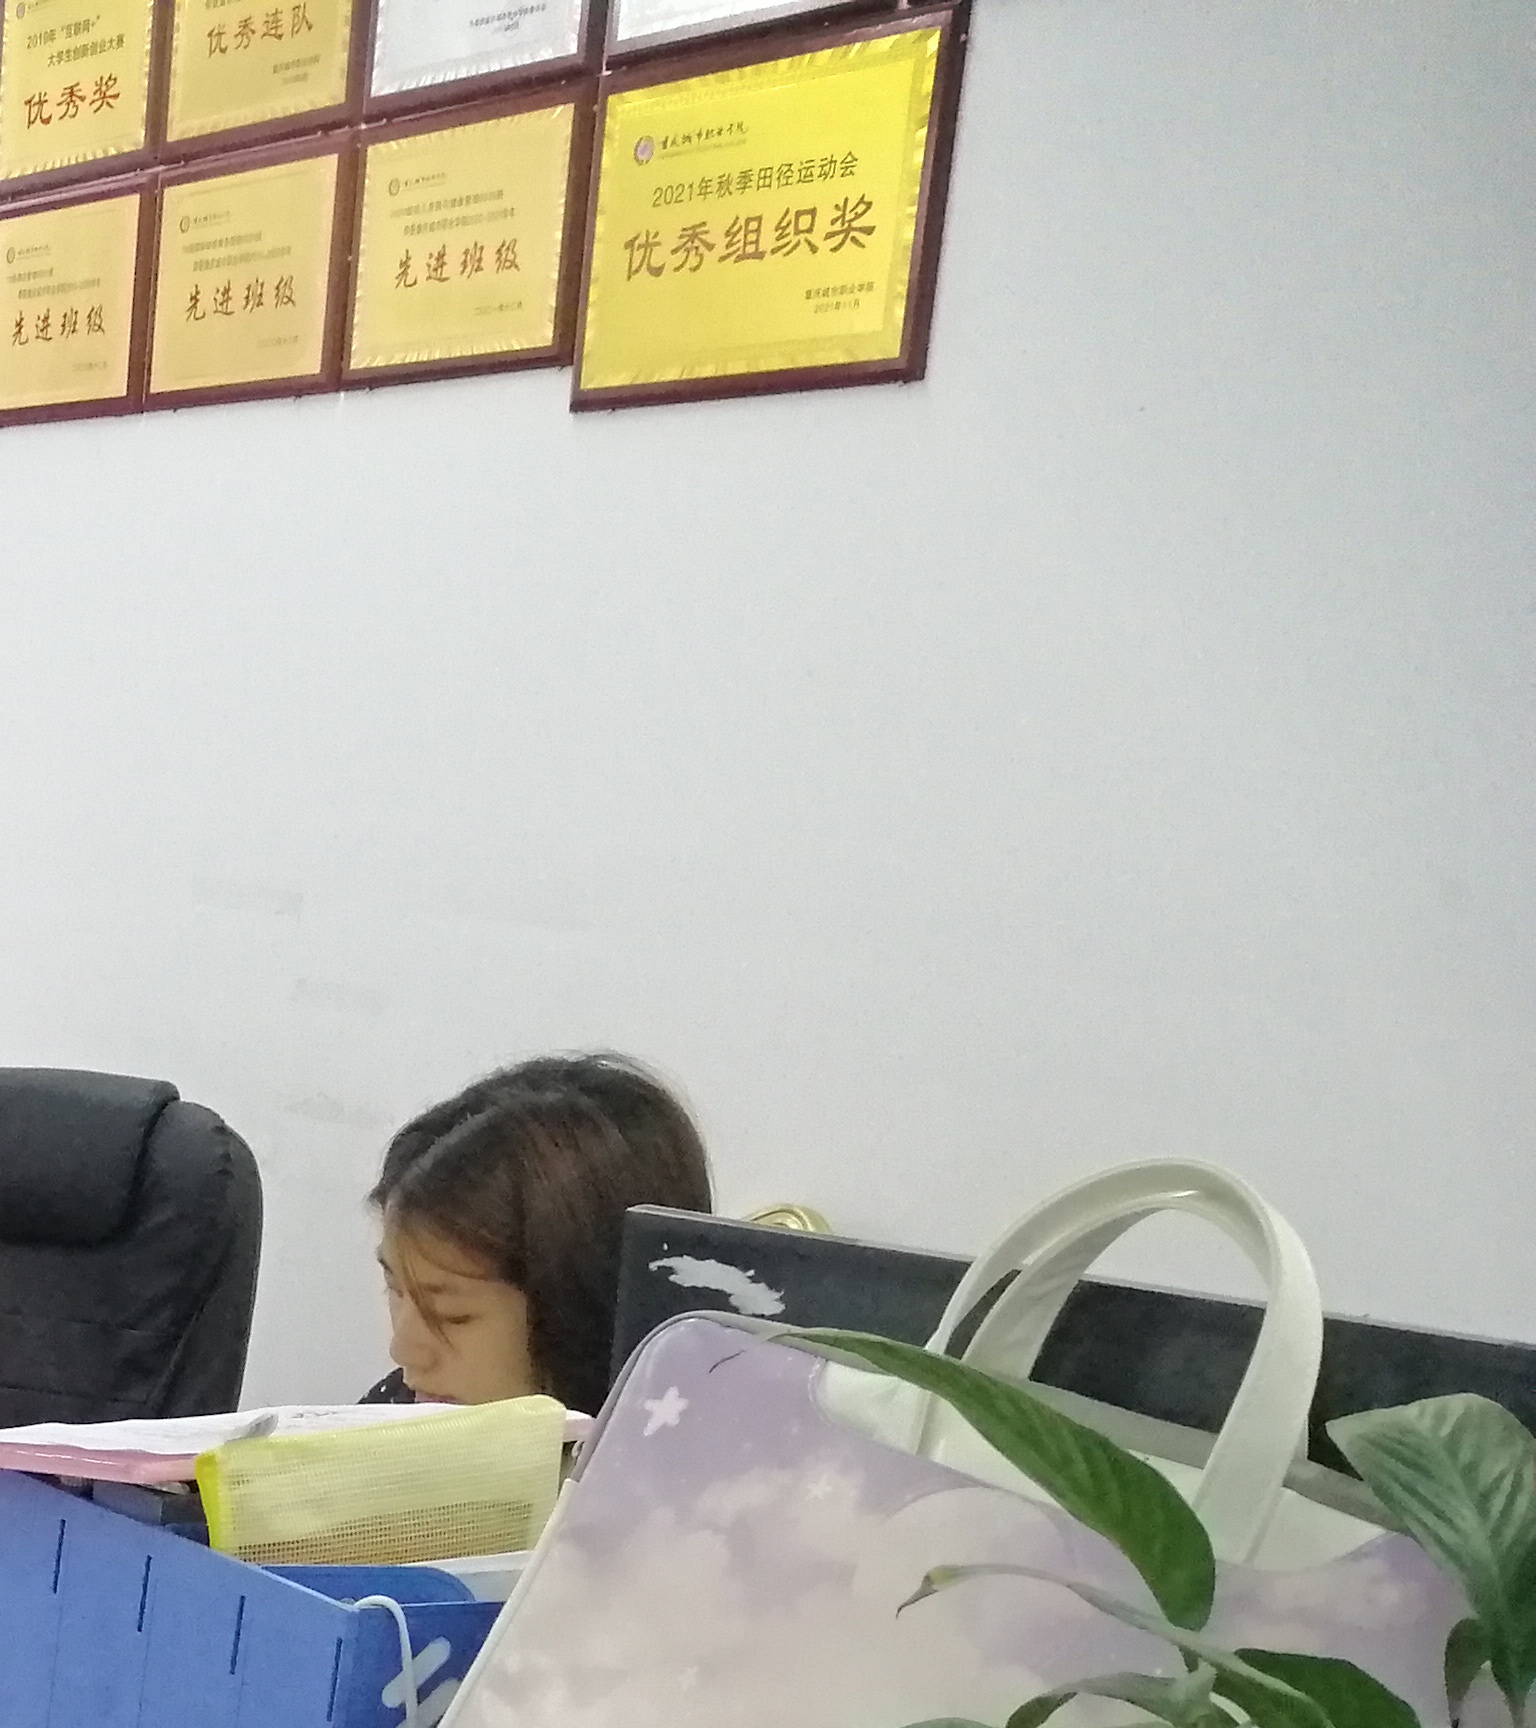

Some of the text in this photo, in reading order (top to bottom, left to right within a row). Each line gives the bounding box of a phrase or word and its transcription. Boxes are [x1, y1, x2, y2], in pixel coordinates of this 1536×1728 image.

[207, 2, 313, 57] 优秀连队
[24, 73, 121, 129] 优秀奖
[652, 151, 859, 208] 2021年秋季田径运动会
[395, 238, 520, 289] 先进班级
[624, 193, 877, 281] 优秀组织奖
[12, 304, 106, 346] 先进班级
[186, 275, 296, 322] 先进班级
